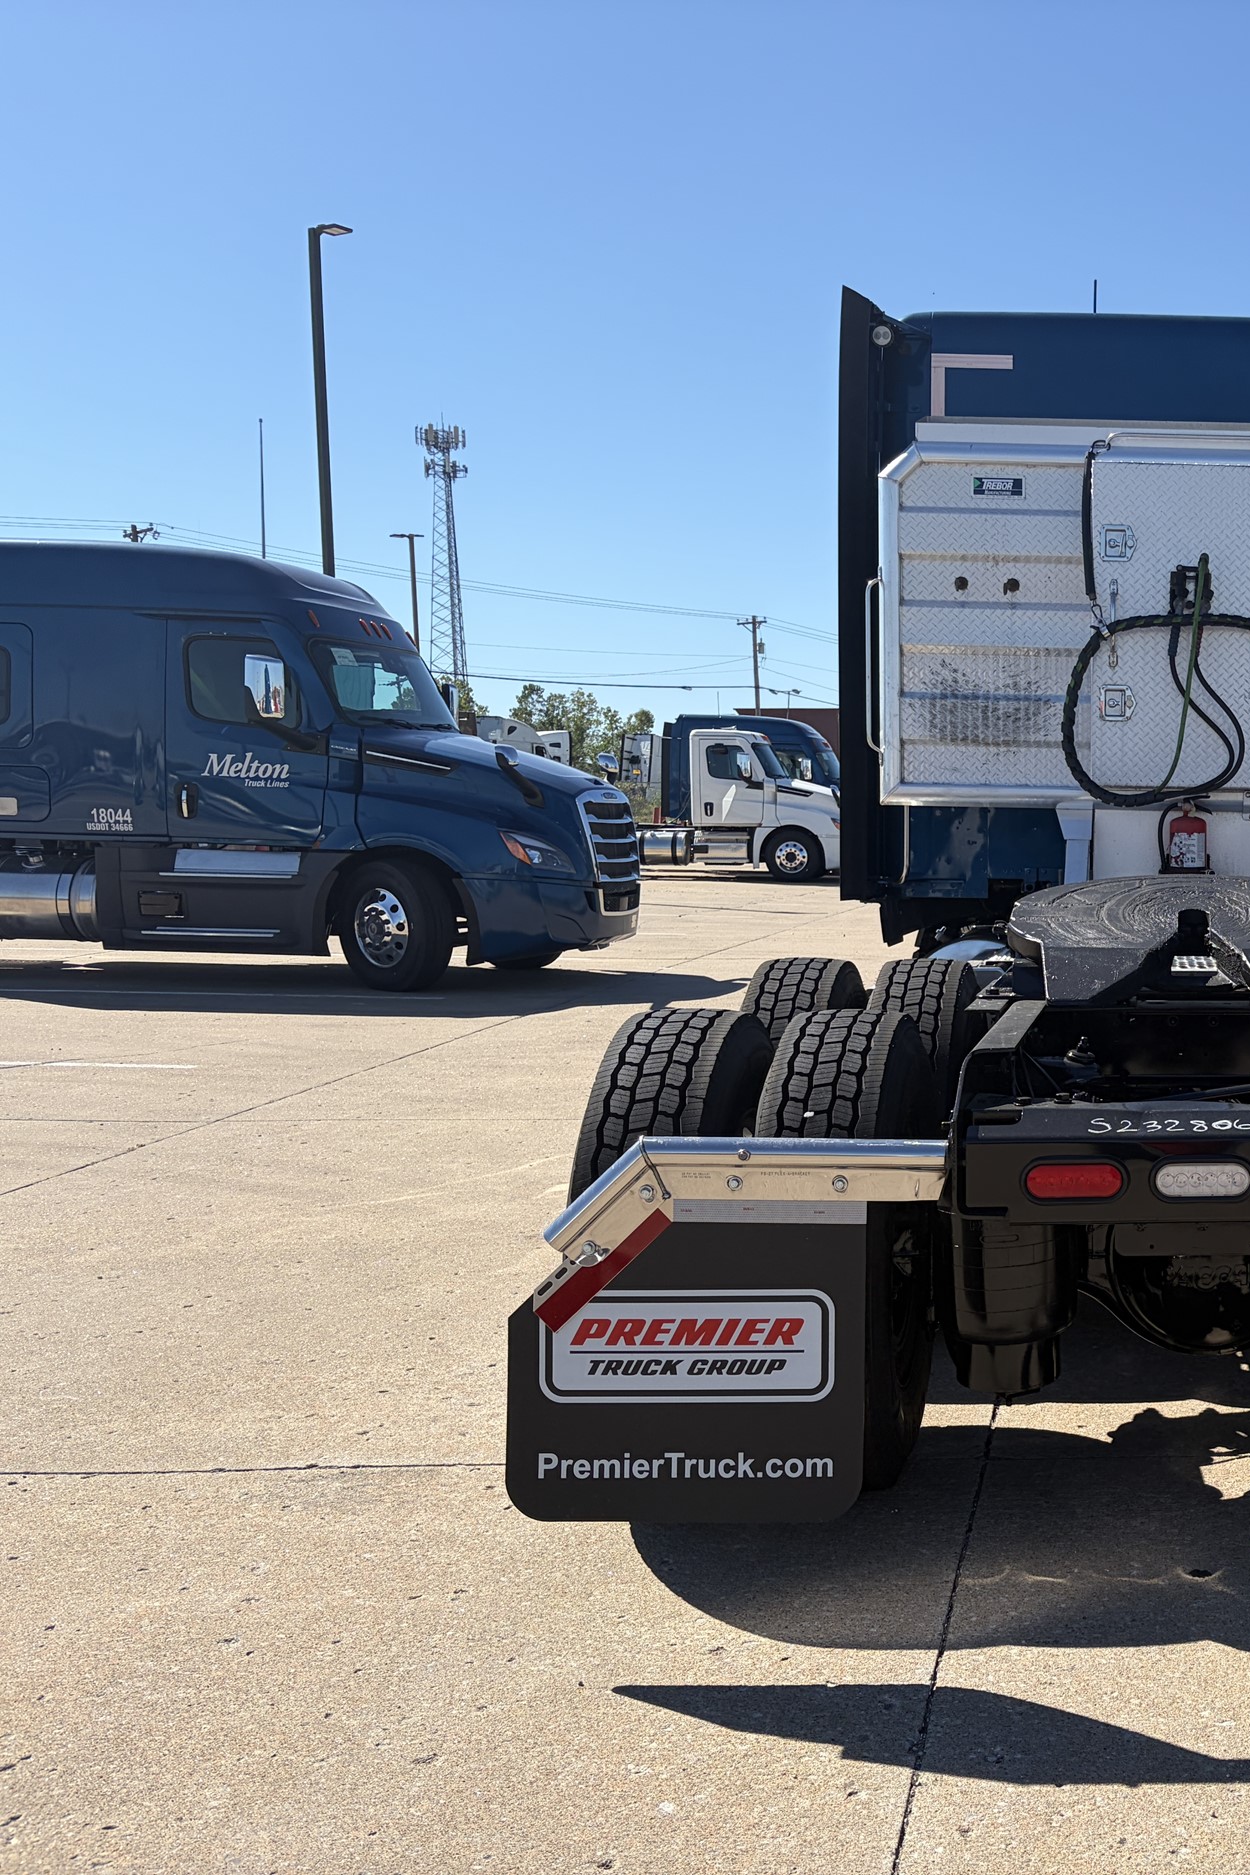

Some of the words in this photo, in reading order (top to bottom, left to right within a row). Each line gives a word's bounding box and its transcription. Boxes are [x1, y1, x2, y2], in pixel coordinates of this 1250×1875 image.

[982, 479, 1014, 490] TREBOR
[201, 753, 290, 779] Melton
[244, 779, 265, 788] Truck
[267, 780, 290, 788] Lines
[91, 809, 133, 823] 18044
[86, 823, 109, 831] USDOT
[111, 824, 134, 832] 34666
[569, 1318, 805, 1346] PREMIER
[587, 1359, 684, 1376] TRUCK
[686, 1358, 788, 1375] GROUP
[537, 1452, 834, 1479] PremierTruck.com
